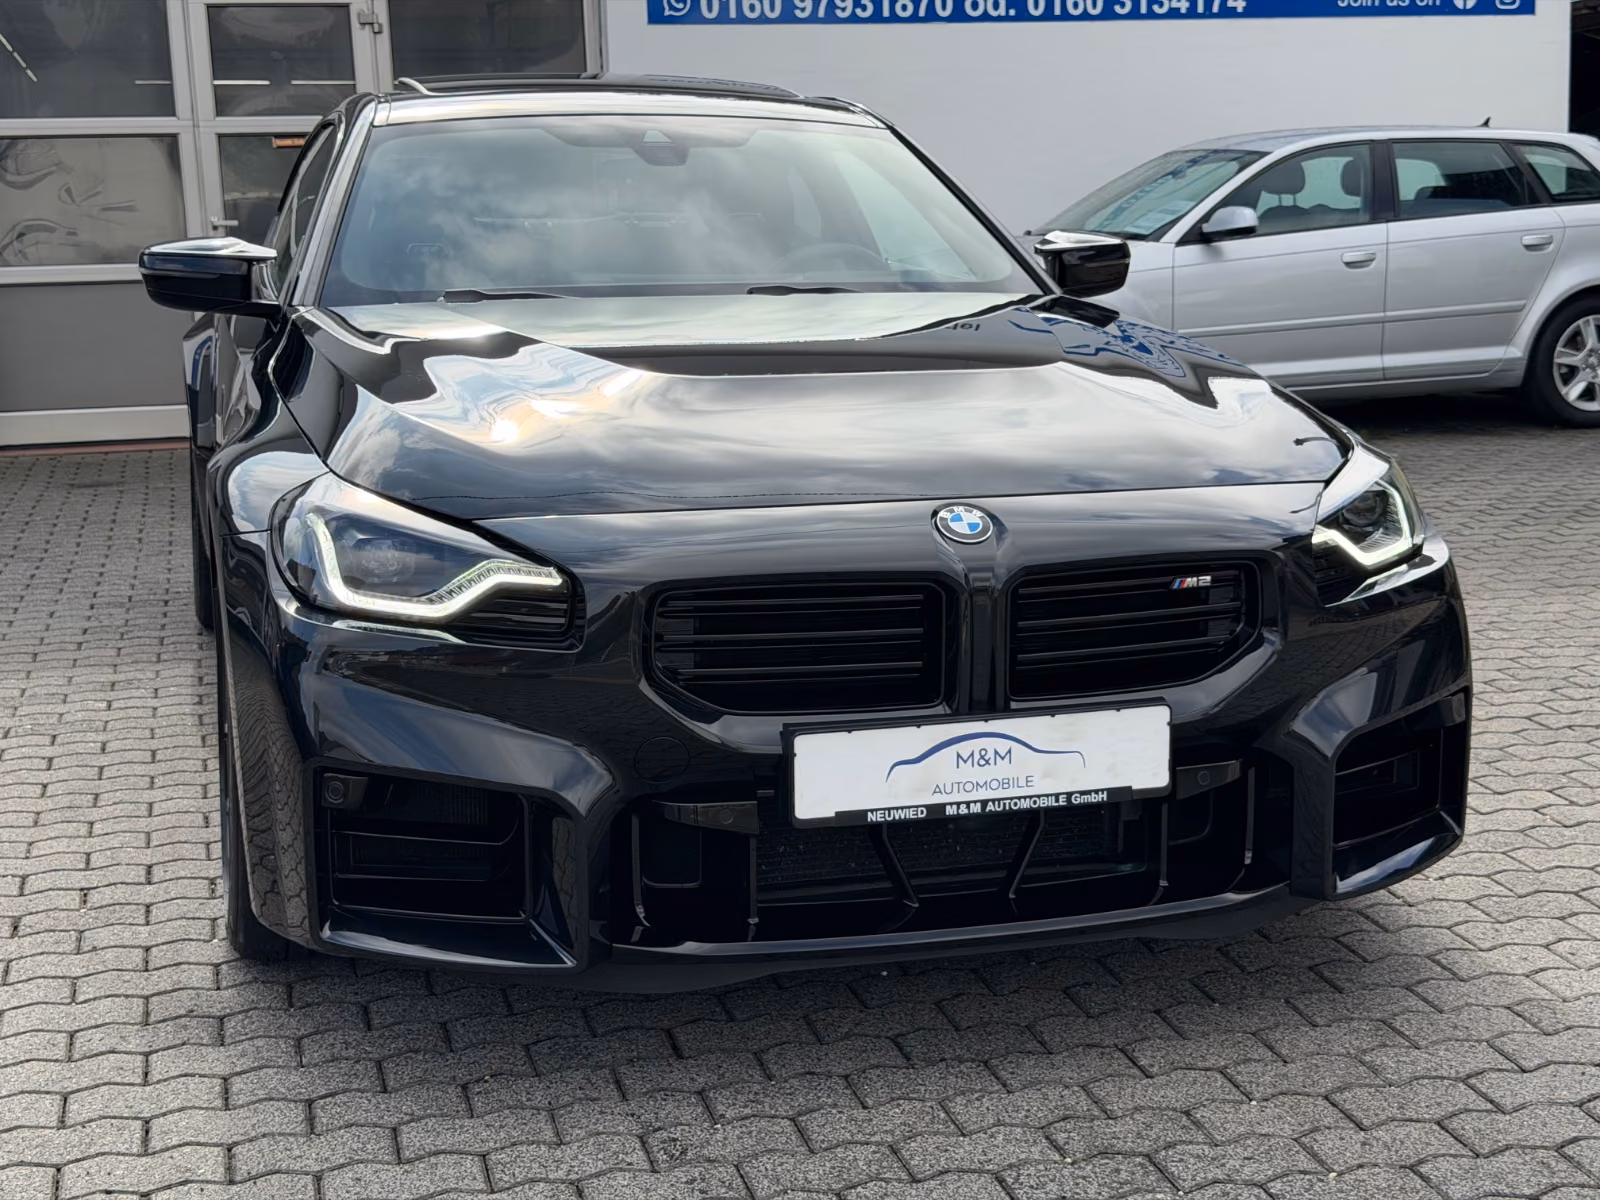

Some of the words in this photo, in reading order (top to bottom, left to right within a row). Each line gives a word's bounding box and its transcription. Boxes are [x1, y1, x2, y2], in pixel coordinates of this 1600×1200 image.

[699, 0, 782, 19] 0160
[793, 0, 954, 18] 97931870
[964, 0, 1016, 17] od.
[1027, 0, 1104, 16] 0160
[938, 505, 984, 519] BMW
[956, 746, 1012, 769] M&M
[931, 775, 1035, 796] AUTOMOBILE
[867, 807, 927, 822] NEUWIED
[945, 802, 982, 816] M&M
[985, 795, 1067, 812] AUTOMOBILE
[1071, 791, 1108, 805] GmbH
